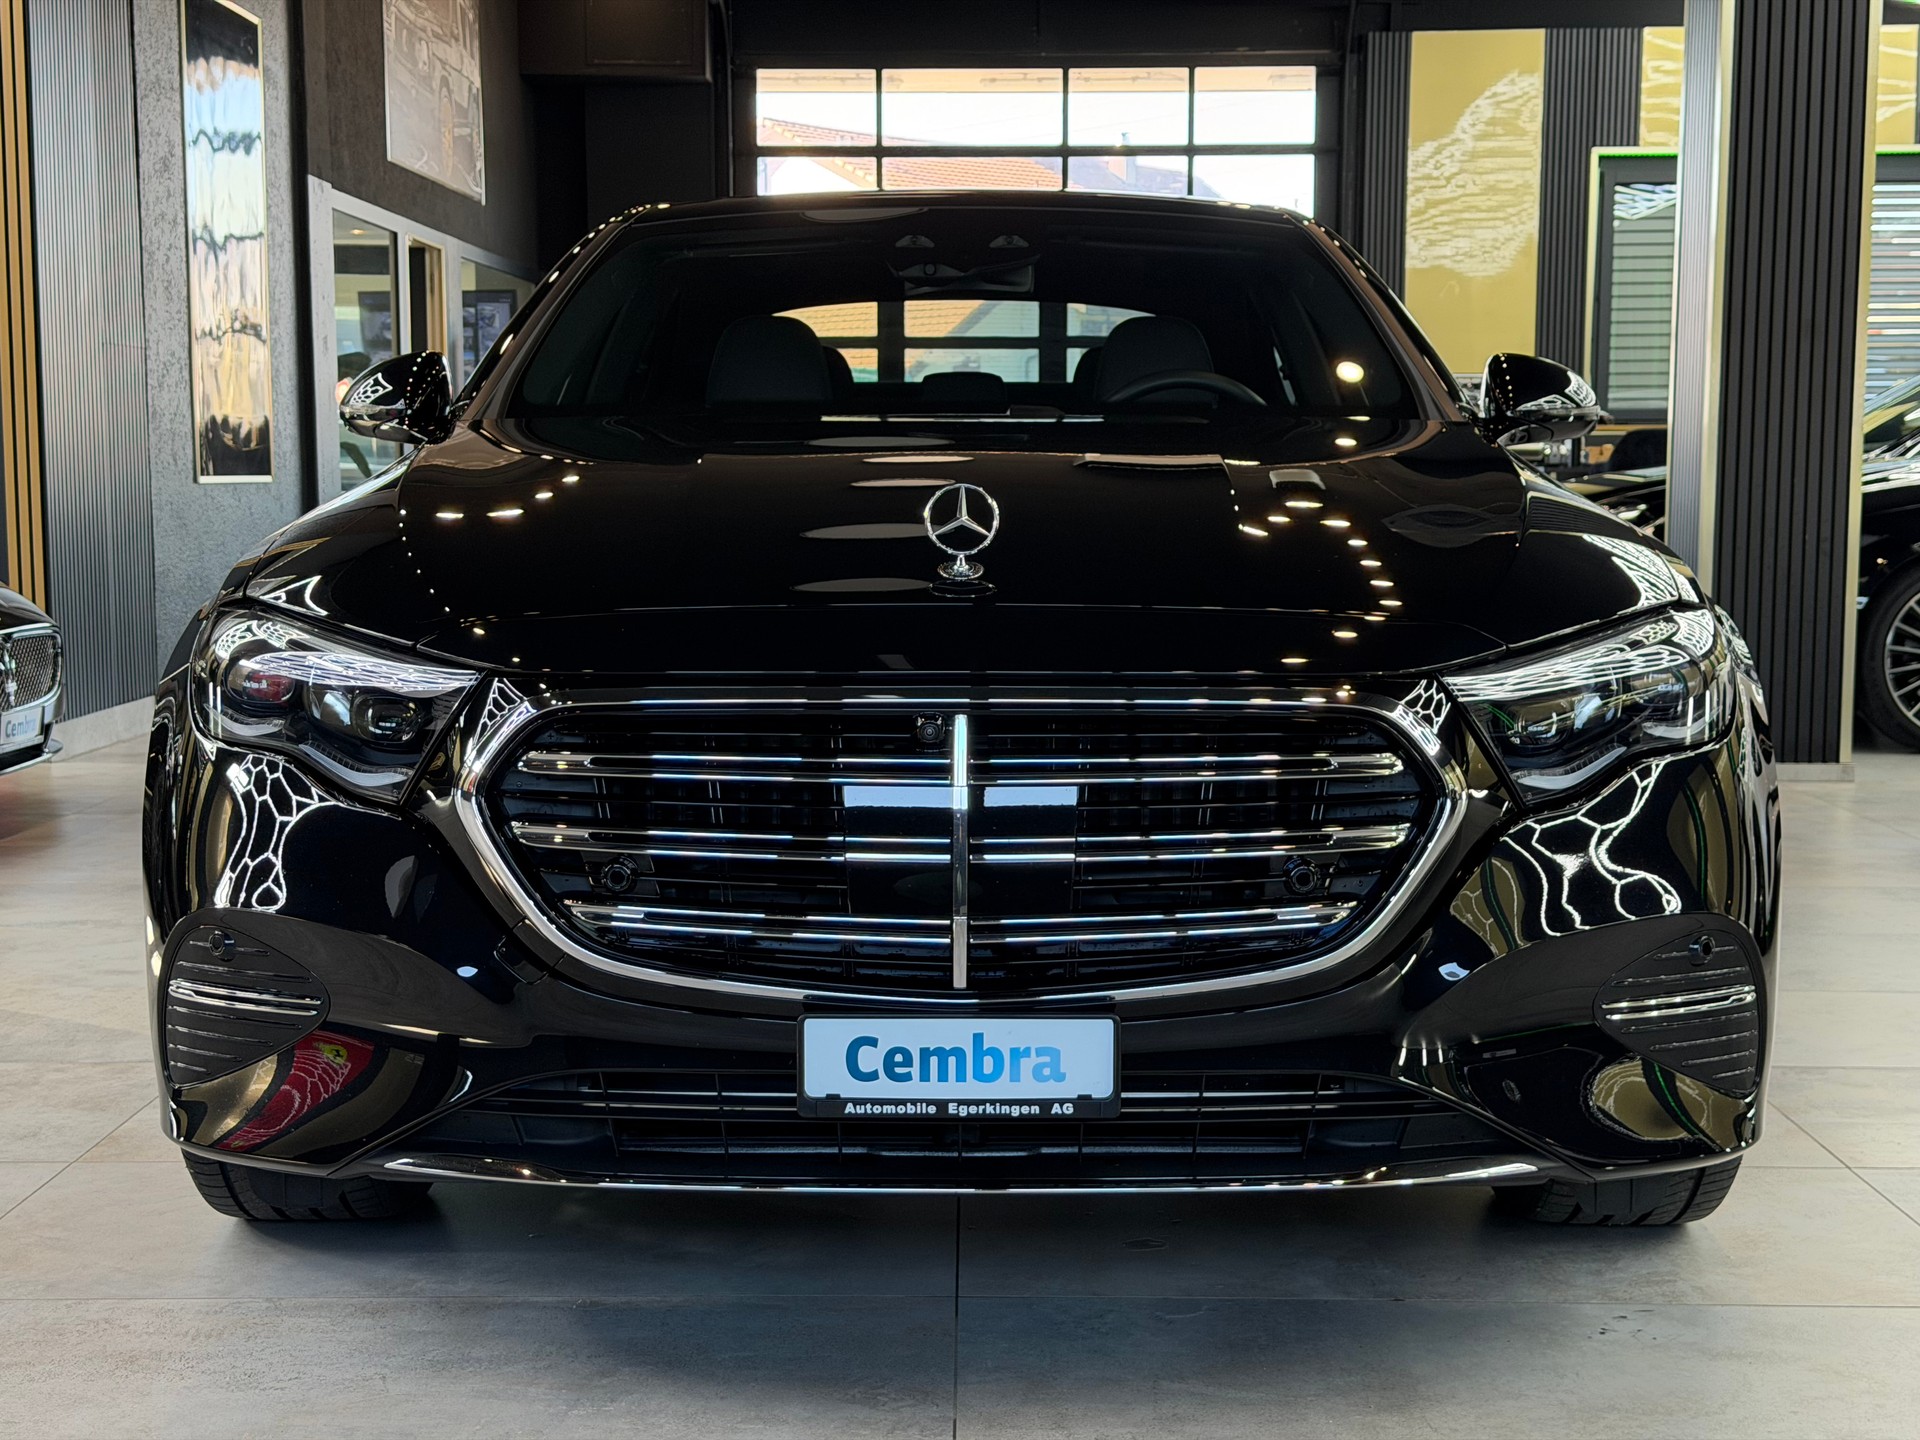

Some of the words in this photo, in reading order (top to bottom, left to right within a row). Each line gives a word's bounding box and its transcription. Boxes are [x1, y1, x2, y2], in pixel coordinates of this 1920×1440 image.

[845, 1032, 1066, 1083] Cembra
[844, 1102, 937, 1115] Automobile
[948, 1102, 1040, 1117] Egerkingen
[1050, 1103, 1074, 1115] AG
